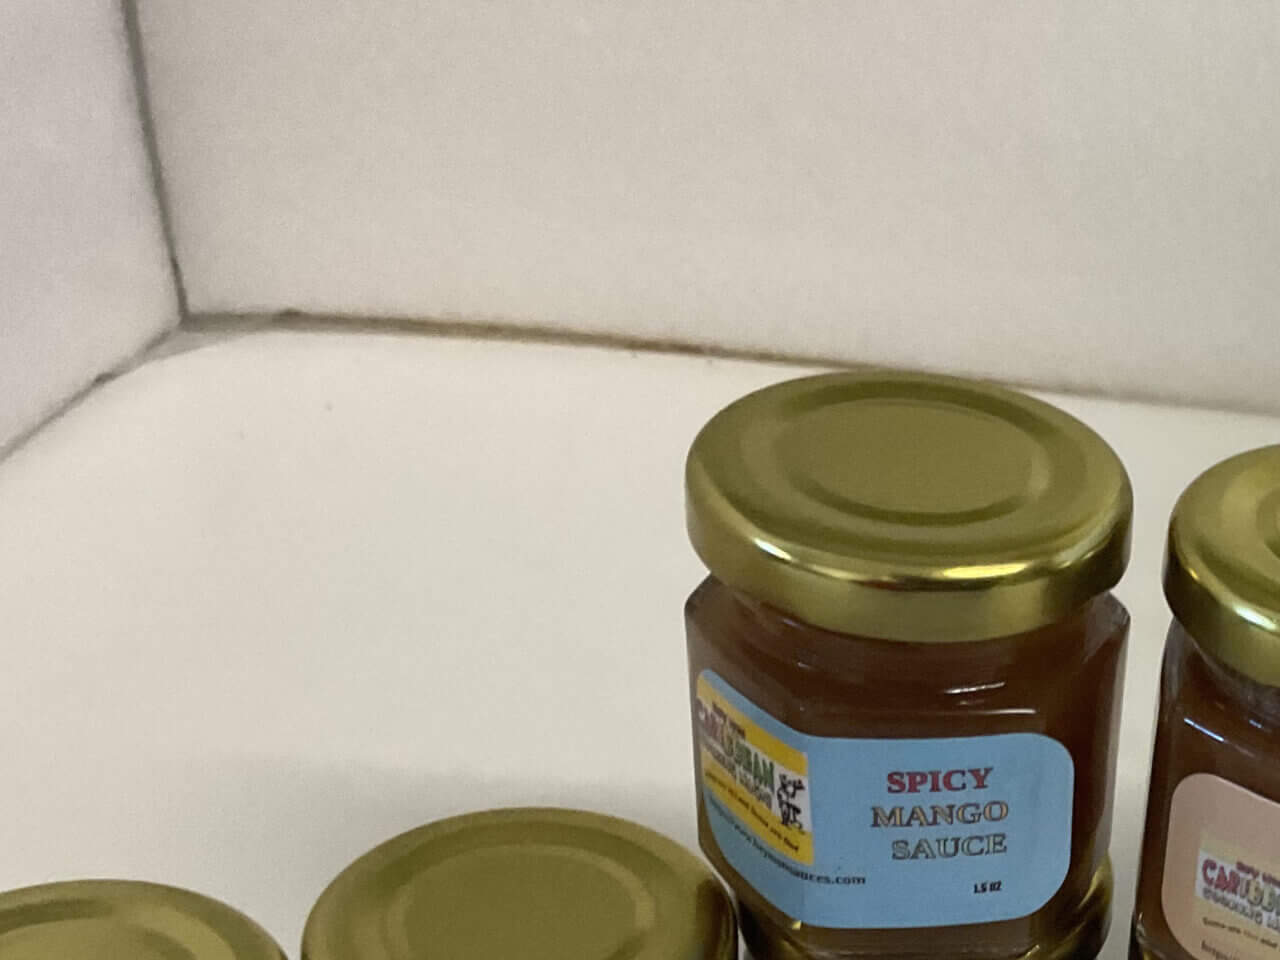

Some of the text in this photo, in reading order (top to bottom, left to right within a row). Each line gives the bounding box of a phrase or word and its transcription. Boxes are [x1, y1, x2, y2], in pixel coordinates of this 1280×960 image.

[887, 767, 993, 794] SPICY
[871, 800, 1009, 828] MANGO
[891, 832, 1008, 860] SAUCE
